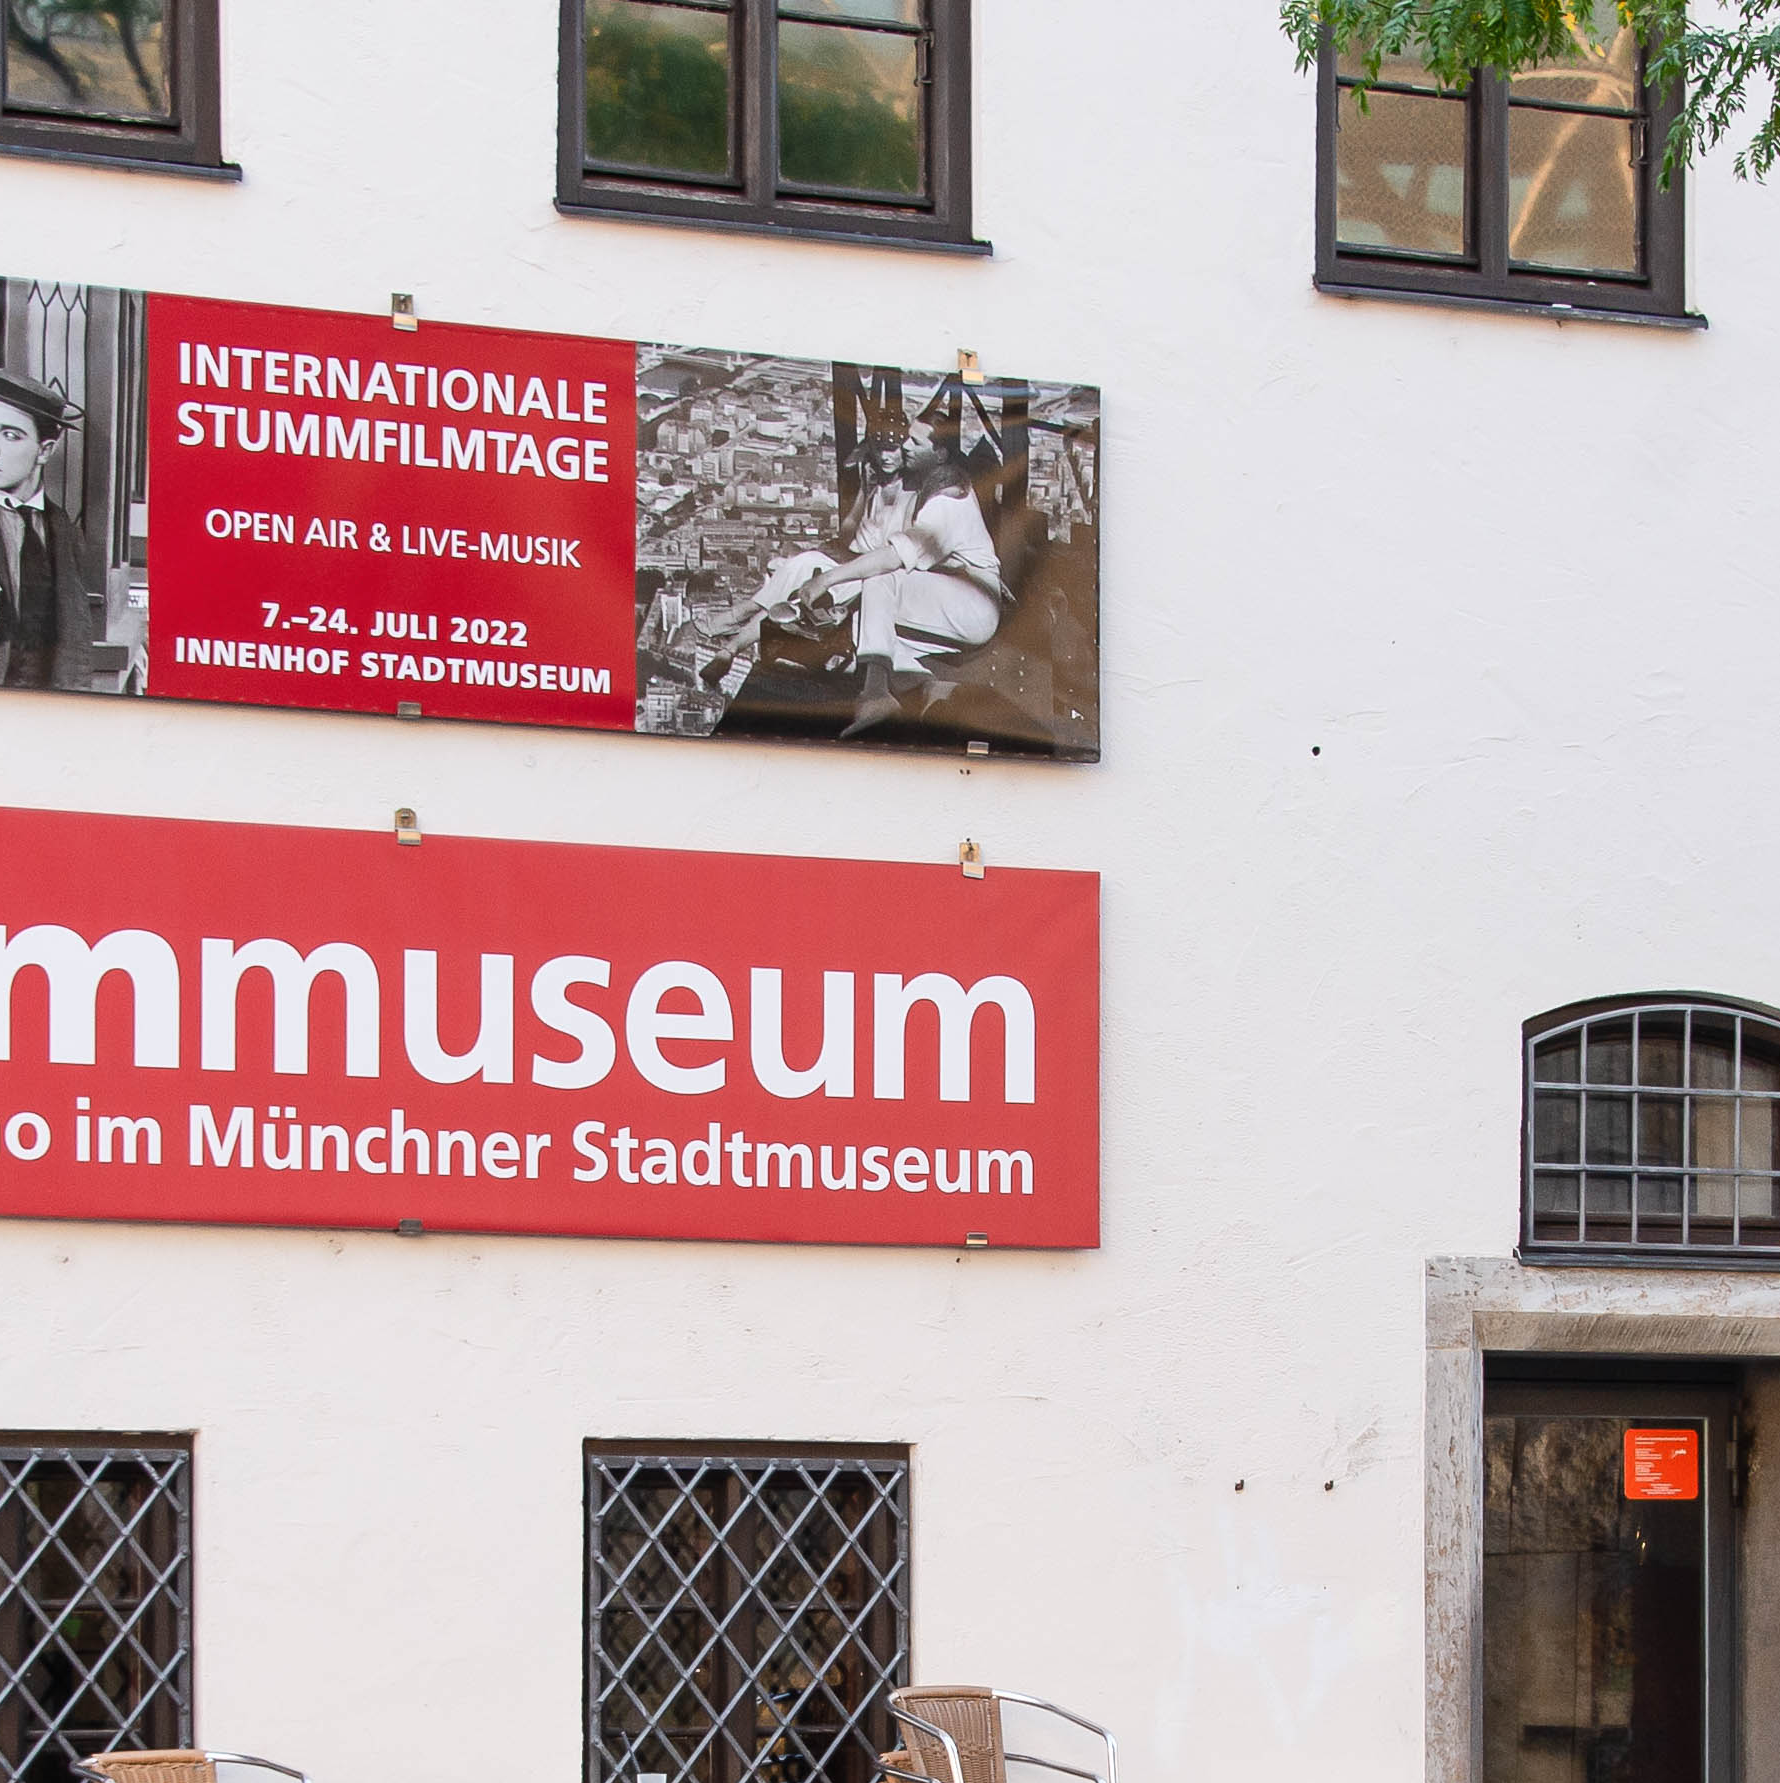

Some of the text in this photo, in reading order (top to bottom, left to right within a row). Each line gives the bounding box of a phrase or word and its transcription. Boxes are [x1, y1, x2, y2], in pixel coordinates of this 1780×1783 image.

[179, 342, 607, 424] INTERNATIONALE
[177, 401, 609, 483] STUMMFILMTAGE
[205, 508, 581, 568] OPEN AIR & LIVE-MUSIK
[175, 636, 611, 694] INNENHOF STADTMUSEUM
[370, 611, 437, 641] JULI
[450, 617, 528, 648] 2022
[76, 1096, 162, 1165] im
[189, 1104, 552, 1179] Münchner
[572, 1120, 1034, 1195] Stadtmuseum
